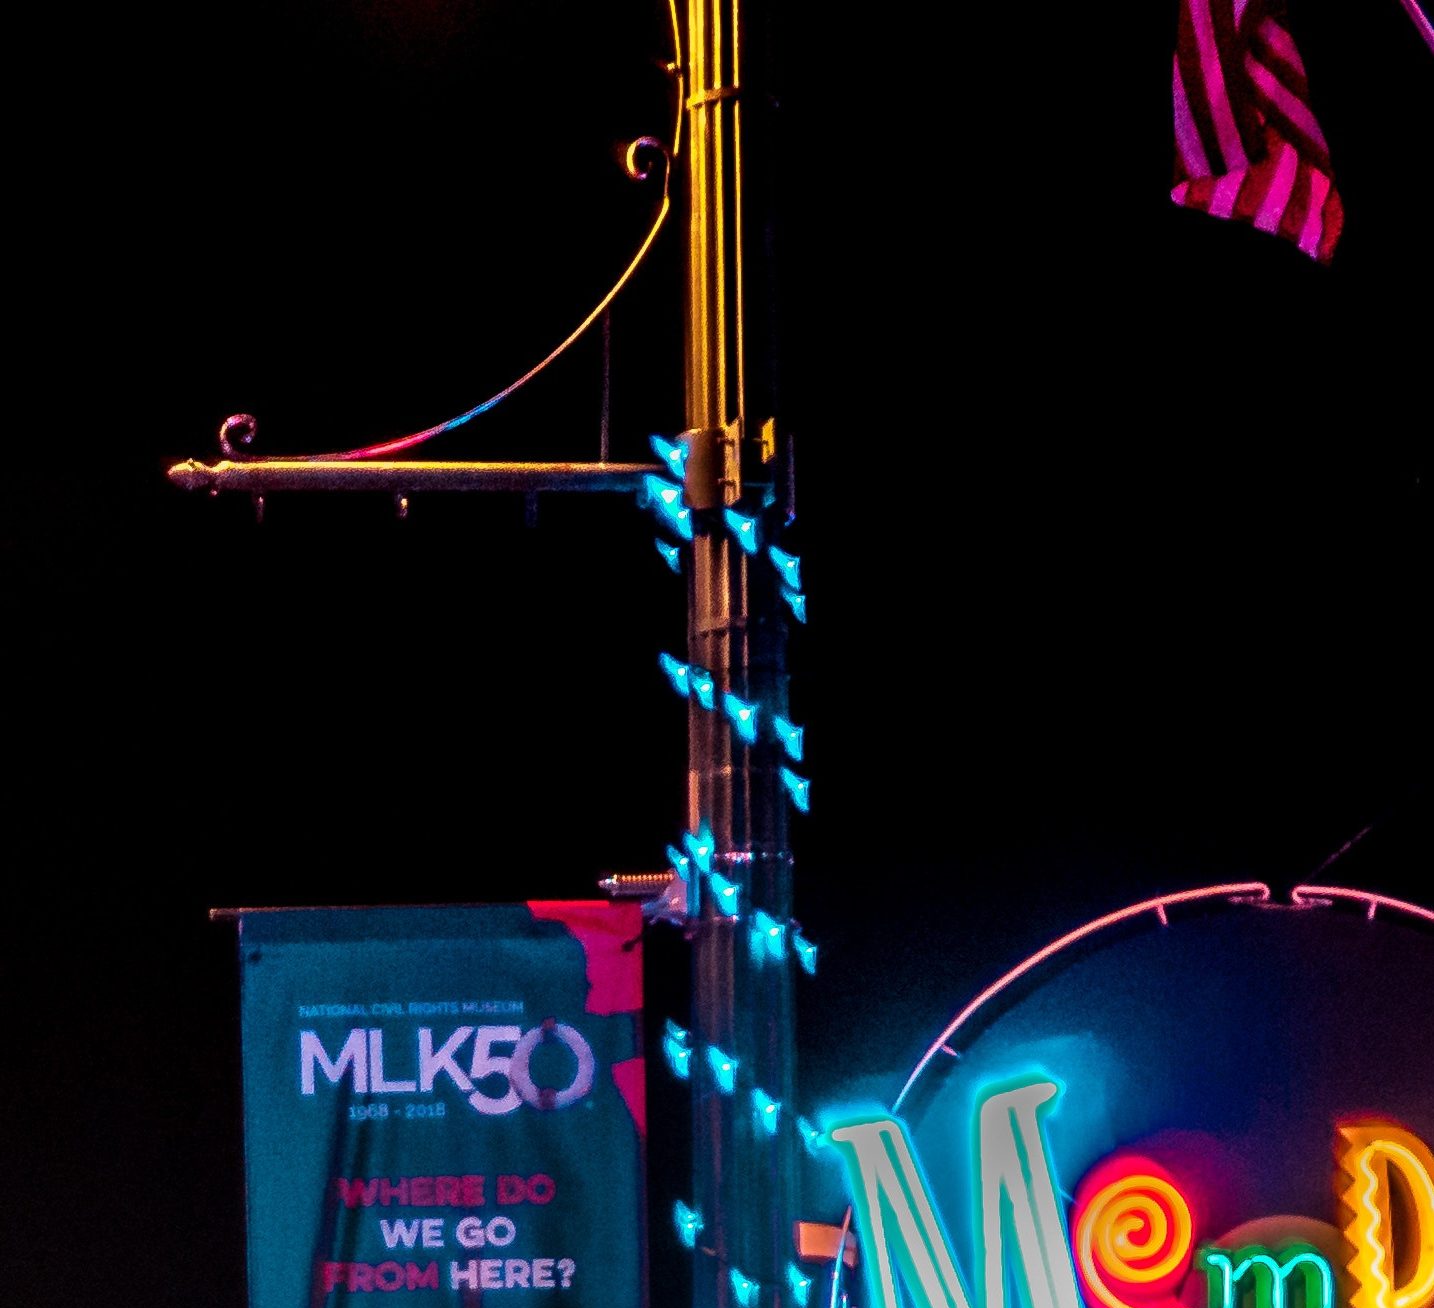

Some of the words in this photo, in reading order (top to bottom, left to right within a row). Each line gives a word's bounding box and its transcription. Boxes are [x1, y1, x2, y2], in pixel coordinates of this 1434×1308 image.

[299, 1023, 595, 1115] MLK50
[405, 1102, 445, 1120] 2018
[336, 1174, 485, 1208] WHERE
[496, 1173, 557, 1204] DO
[380, 1217, 445, 1248] WE
[455, 1215, 516, 1248] GO
[324, 1260, 439, 1293] FROM
[450, 1257, 576, 1290] HERE?
